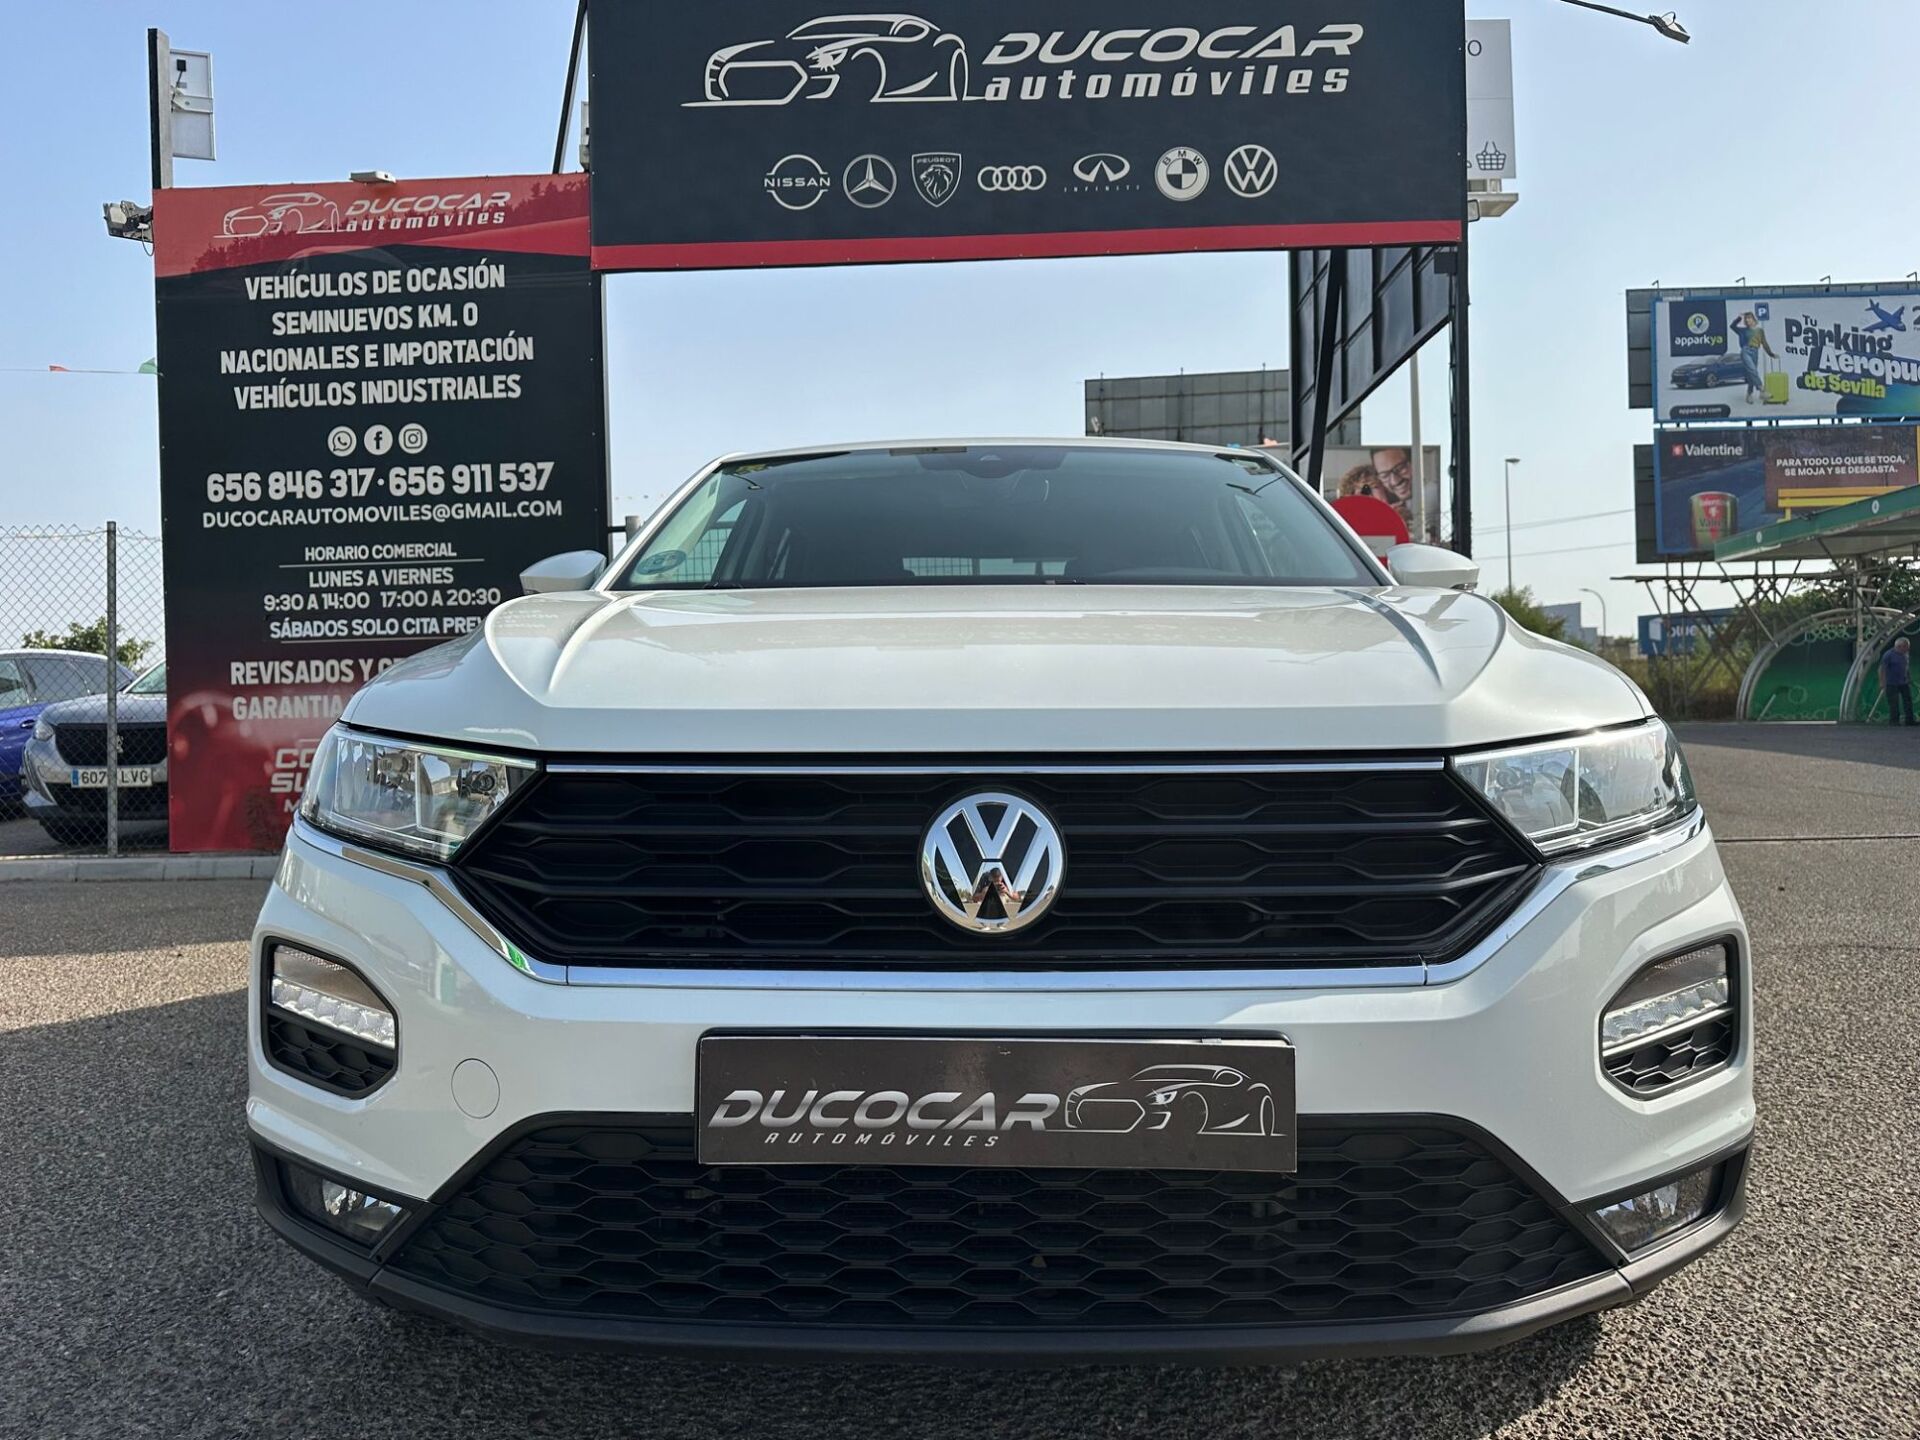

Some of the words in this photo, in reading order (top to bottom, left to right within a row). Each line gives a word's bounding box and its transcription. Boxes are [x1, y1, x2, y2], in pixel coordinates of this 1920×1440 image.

[982, 23, 1364, 65] DUCOCAR
[983, 65, 1348, 102] automóviles
[1161, 150, 1202, 166] BMW
[764, 177, 831, 188] NISSAN
[1064, 184, 1140, 193] INFINITI
[346, 191, 511, 216] DUCOCAR
[347, 211, 505, 233] automóviles
[245, 269, 367, 301] VEHÍCULOS
[373, 270, 401, 294] DE
[407, 258, 505, 292] OCASIÓN
[272, 305, 413, 336] SEMINUEVOS
[418, 304, 458, 330] KM.
[1803, 314, 1818, 327] Tu
[1674, 334, 1723, 347] apparkya
[1785, 317, 1893, 359] Parking
[220, 344, 359, 375] NACIONALES
[365, 343, 379, 368] E
[384, 331, 534, 367] IMPORTACIÓN
[1785, 346, 1797, 355] en
[234, 377, 356, 410] VEHÍCULOS
[362, 374, 521, 404] INDUSTRIALES
[1804, 371, 1826, 388] de
[1829, 374, 1886, 398] Sevilla
[1684, 443, 1743, 456] Valentine
[1776, 458, 1801, 467] PARA
[1803, 457, 1830, 466] TODO
[1831, 457, 1842, 465] LO
[1844, 456, 1864, 465] QUE
[1864, 455, 1876, 464] SE
[1877, 455, 1906, 465] TOCA,
[207, 473, 262, 502] 656
[268, 469, 323, 500] 846
[451, 465, 493, 494] 911
[499, 462, 554, 491] 537
[1785, 468, 1796, 476] SE
[1798, 467, 1826, 476] MOJA
[1826, 466, 1833, 475] Y
[1834, 466, 1847, 475] SE
[1847, 465, 1898, 475] DESGASTA.
[203, 500, 562, 528] DUCOCARAUTOMOVILES@GMAIL.COM
[305, 545, 369, 562] HORARIO
[372, 542, 457, 560] COMERCIAL
[309, 570, 364, 588] LUNES
[367, 570, 379, 586] A
[382, 567, 454, 586] VIERNES
[264, 594, 304, 612] 9:30
[307, 593, 320, 610] A
[322, 592, 370, 610] 14:00
[382, 589, 428, 608] 17:00
[431, 589, 444, 606] A
[446, 587, 501, 606] 20:30
[270, 616, 348, 640] SÁBADOS
[352, 617, 399, 637] SOLO
[402, 617, 440, 635] CITA
[443, 616, 482, 634] PRE
[231, 658, 354, 685] REVISADOS
[358, 658, 374, 681] Y
[81, 771, 108, 784] 607
[121, 769, 149, 784] LVG
[924, 790, 1061, 931] VW
[708, 1088, 1061, 1131] DUCOCAR
[764, 1132, 999, 1148] AUTOMÓVILES
